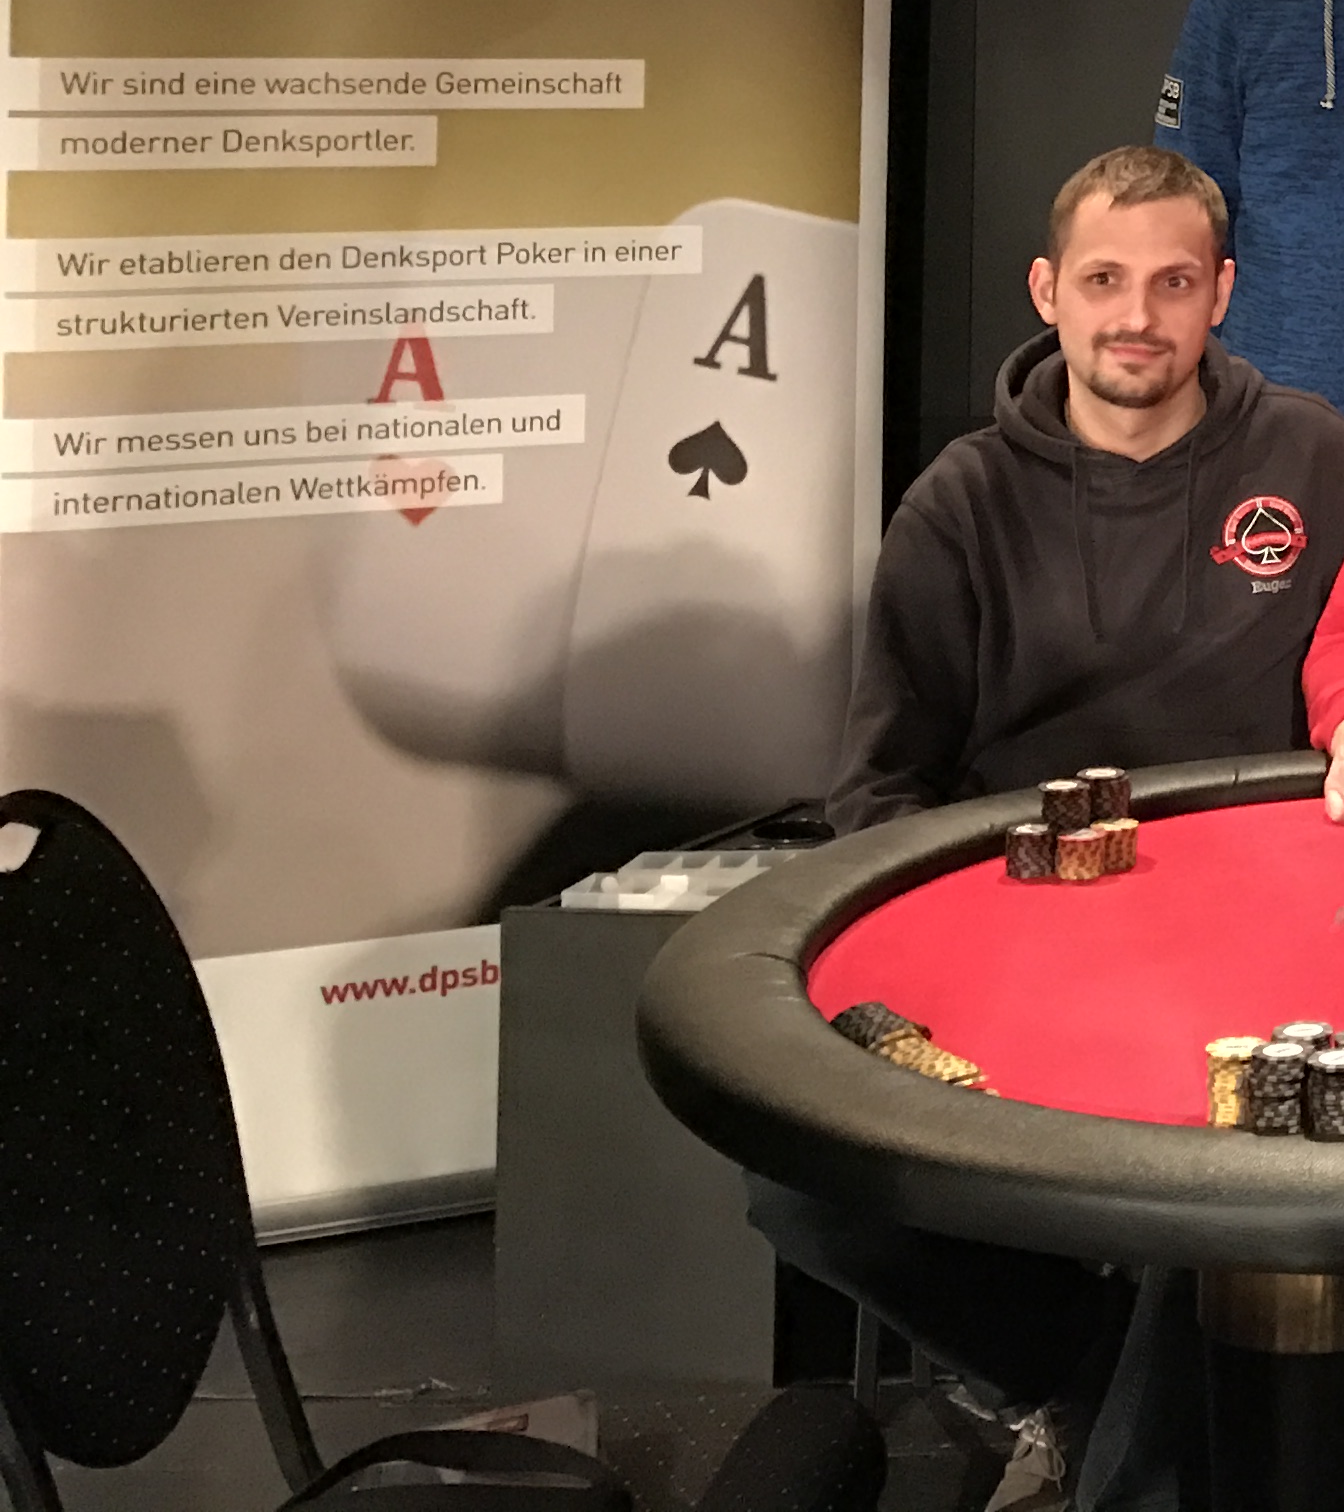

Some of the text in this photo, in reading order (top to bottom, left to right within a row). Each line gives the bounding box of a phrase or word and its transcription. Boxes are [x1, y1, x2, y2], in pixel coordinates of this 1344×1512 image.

[60, 71, 623, 96] Wir sind eine wachsende Gemeinschaft
[60, 128, 416, 158] moderner Denksportler.
[57, 239, 683, 277] Wir etablieren den Denksport Poker in einer
[57, 297, 537, 337] strukturierten Vereinslandschaft.
[693, 272, 778, 382] A
[54, 409, 561, 457] Wir messen uns bei nationalen und
[53, 470, 487, 516] internationalen Wettkämpfen.
